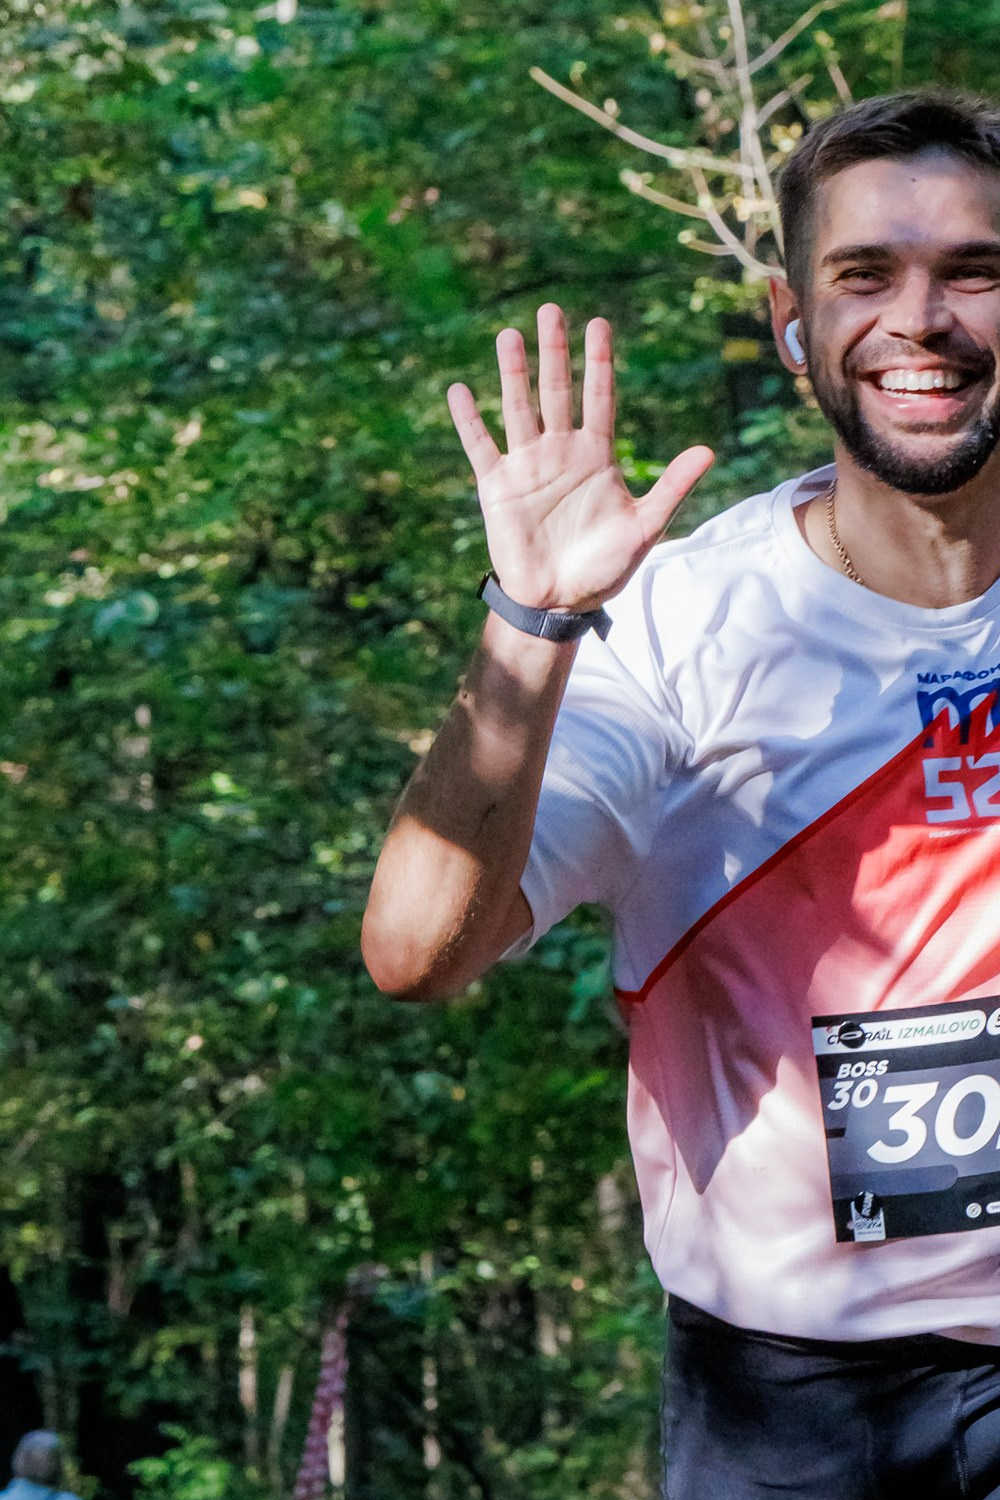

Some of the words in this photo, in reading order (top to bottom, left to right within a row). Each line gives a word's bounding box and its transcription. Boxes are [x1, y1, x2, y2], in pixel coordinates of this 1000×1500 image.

[897, 1018, 981, 1039] IZMAILOVO
[837, 1059, 890, 1079] BOSS
[827, 1079, 879, 1111] 30
